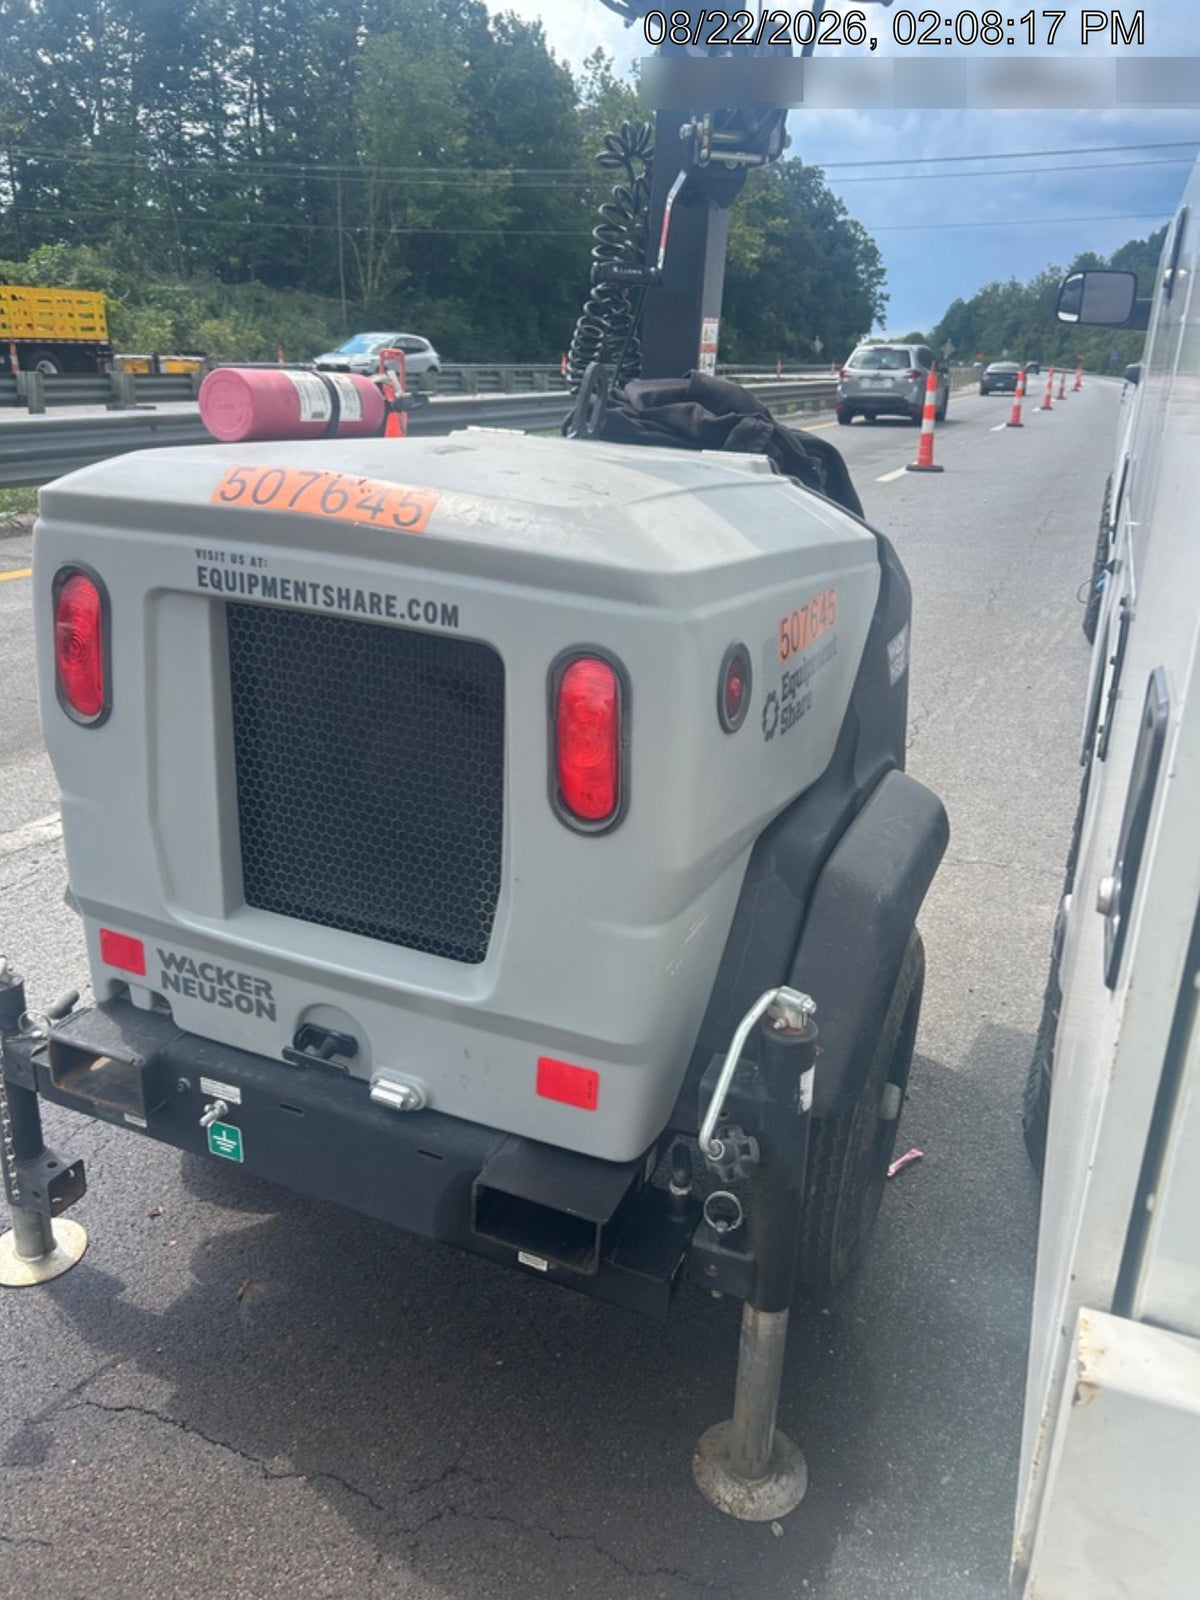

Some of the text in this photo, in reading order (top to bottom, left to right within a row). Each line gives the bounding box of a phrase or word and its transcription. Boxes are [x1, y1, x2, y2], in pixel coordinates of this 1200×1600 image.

[218, 466, 426, 528] 507645
[195, 548, 269, 569] VISIT US AT:
[196, 565, 460, 628] EQUIPMENTSHARE.COM
[780, 588, 836, 661] 507645
[781, 632, 838, 702] Equipt
[156, 948, 275, 1000] WACKER
[160, 969, 277, 1023] NEUSON
